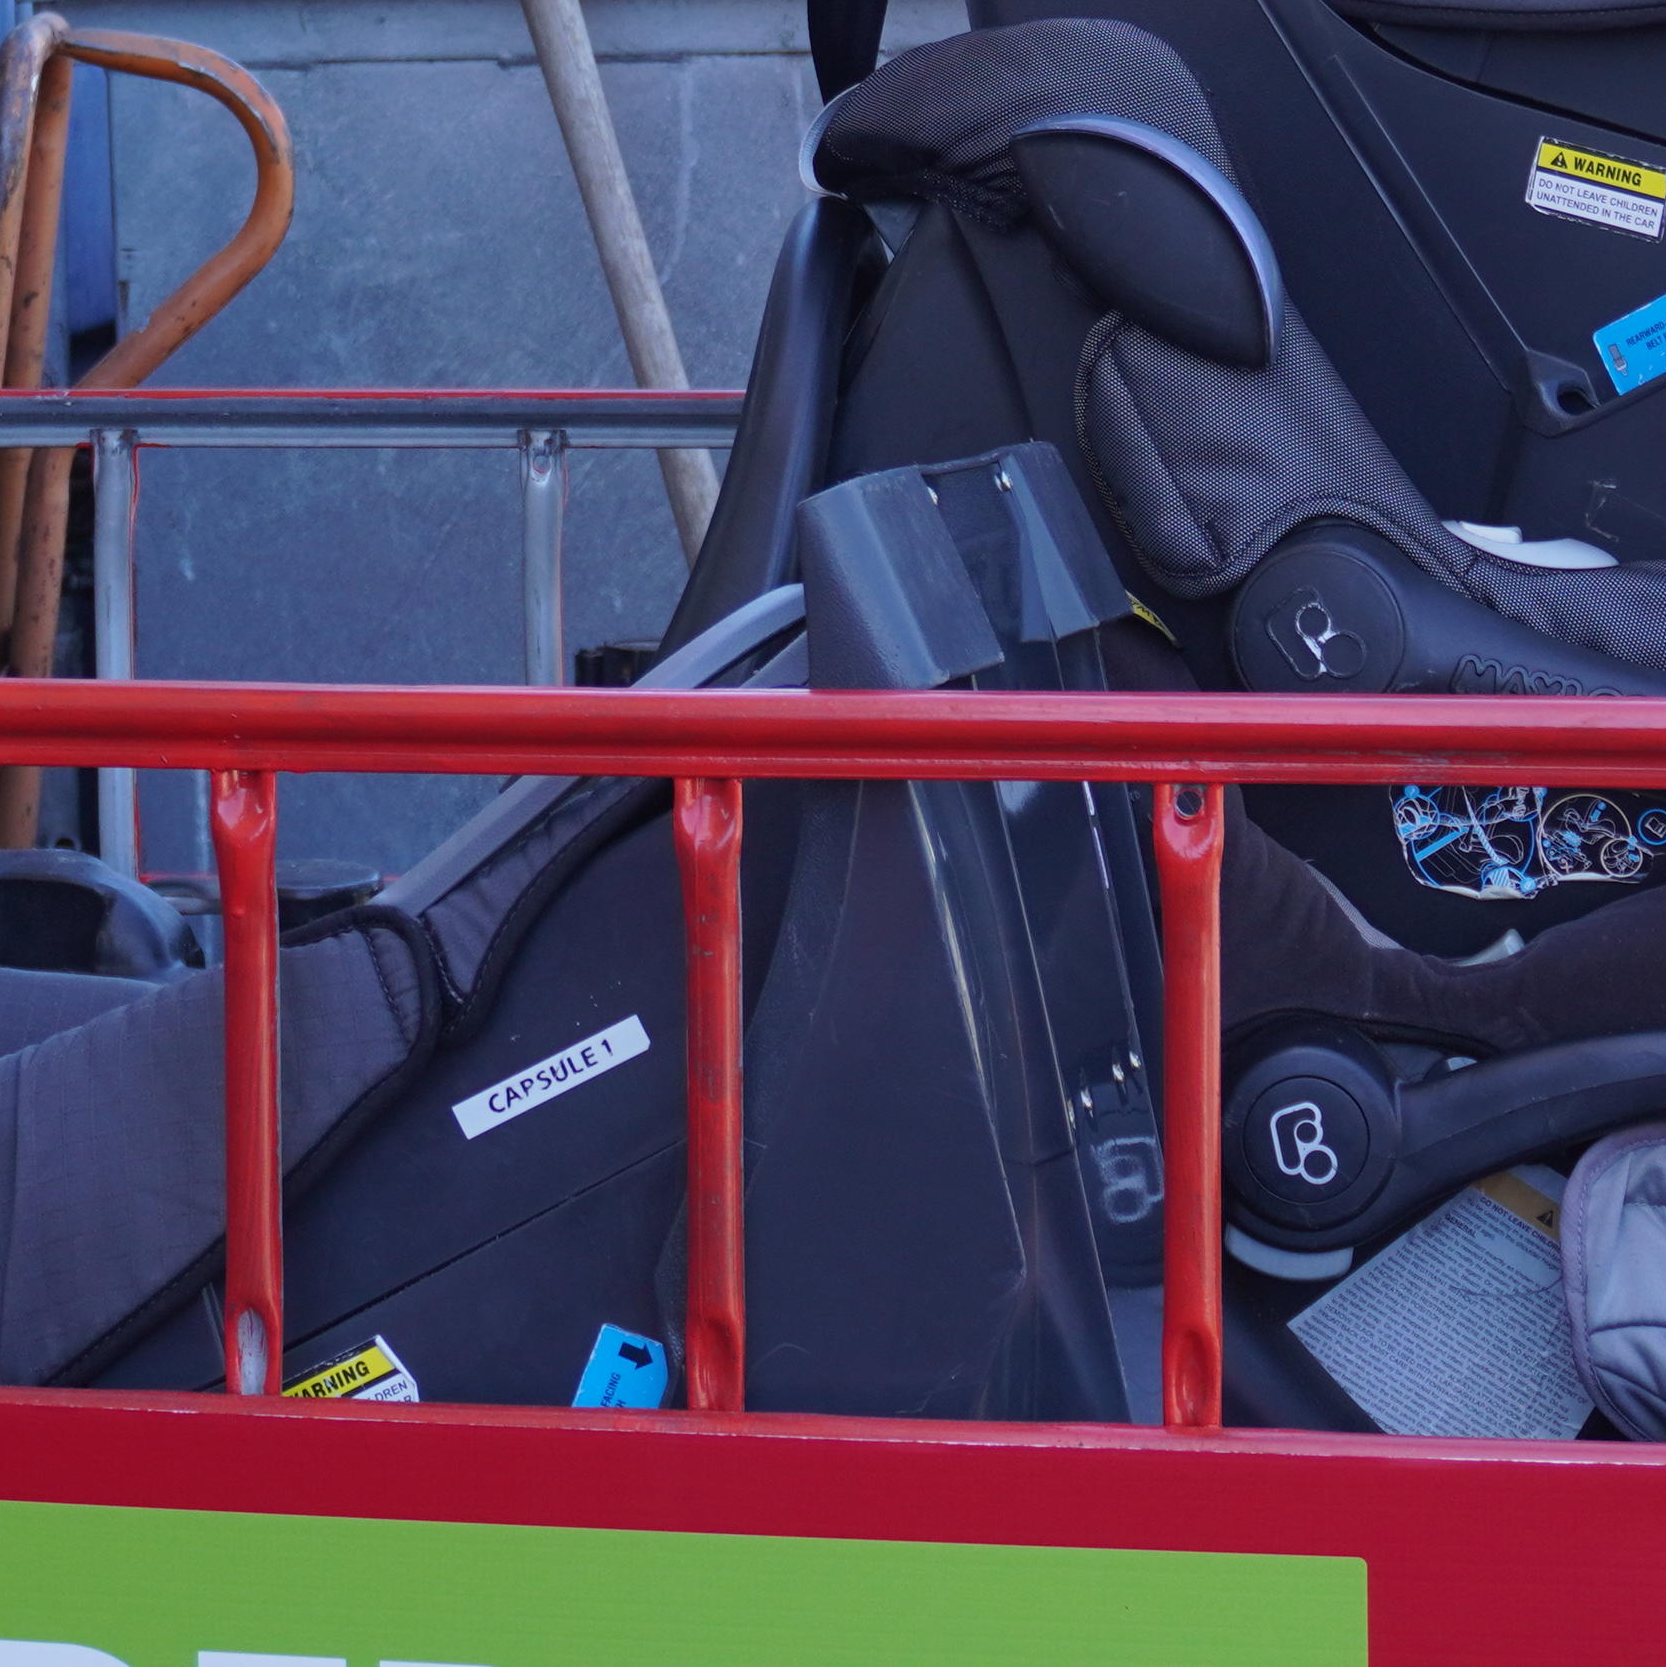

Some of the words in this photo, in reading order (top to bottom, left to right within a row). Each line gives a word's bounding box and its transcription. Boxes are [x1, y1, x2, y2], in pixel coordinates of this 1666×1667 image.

[1573, 156, 1643, 187] WARNING
[1536, 191, 1600, 215] UNATTENDED
[1601, 208, 1612, 218] IN
[1614, 211, 1633, 224] THE
[1634, 217, 1655, 230] CAR
[1538, 178, 1554, 190] DO
[1555, 183, 1576, 196] NOT
[1577, 187, 1608, 205] LEAVE
[1609, 197, 1658, 218] CHILDREN
[1645, 337, 1665, 351] BELT
[488, 1046, 599, 1114] CAPSULE
[601, 1039, 614, 1057] 1
[1506, 1213, 1531, 1233] LEAVE
[292, 1360, 371, 1398] ARNING
